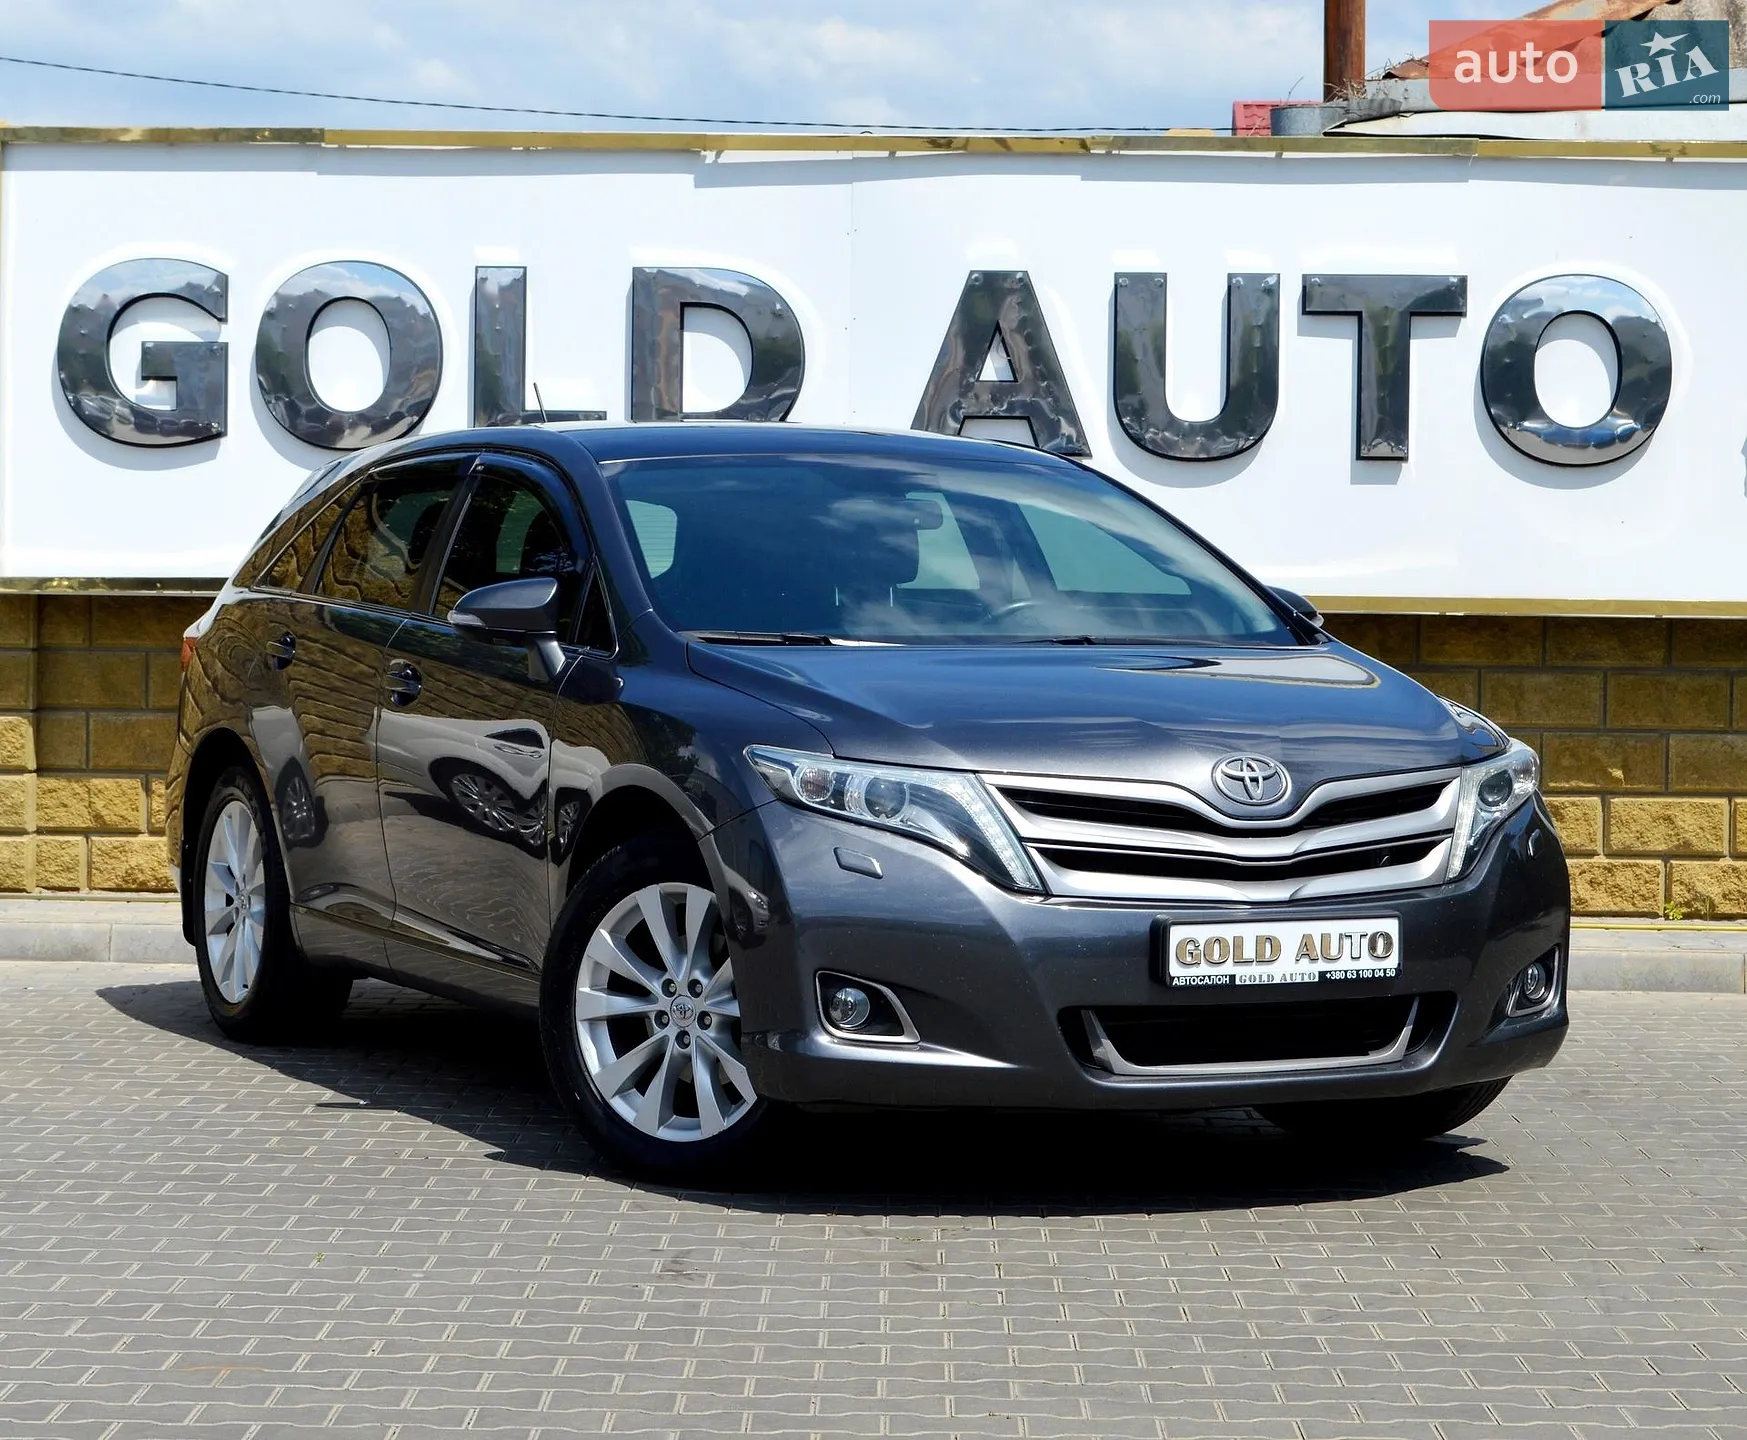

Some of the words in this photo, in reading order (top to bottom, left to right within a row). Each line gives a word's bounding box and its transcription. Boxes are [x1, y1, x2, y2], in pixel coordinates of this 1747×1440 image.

[57, 257, 805, 449] GOLD
[910, 270, 1673, 466] AUTO
[1175, 934, 1282, 966] GOLD
[1295, 930, 1395, 962] AUTO
[1238, 973, 1275, 984] GOLD
[1279, 972, 1317, 983] AUTO
[1325, 970, 1346, 980] +380
[1346, 970, 1357, 980] 63
[1358, 969, 1373, 979] 100
[1374, 969, 1384, 979] 04
[1385, 968, 1396, 978] 50
[1172, 975, 1230, 986] АВТОСАЛОН
